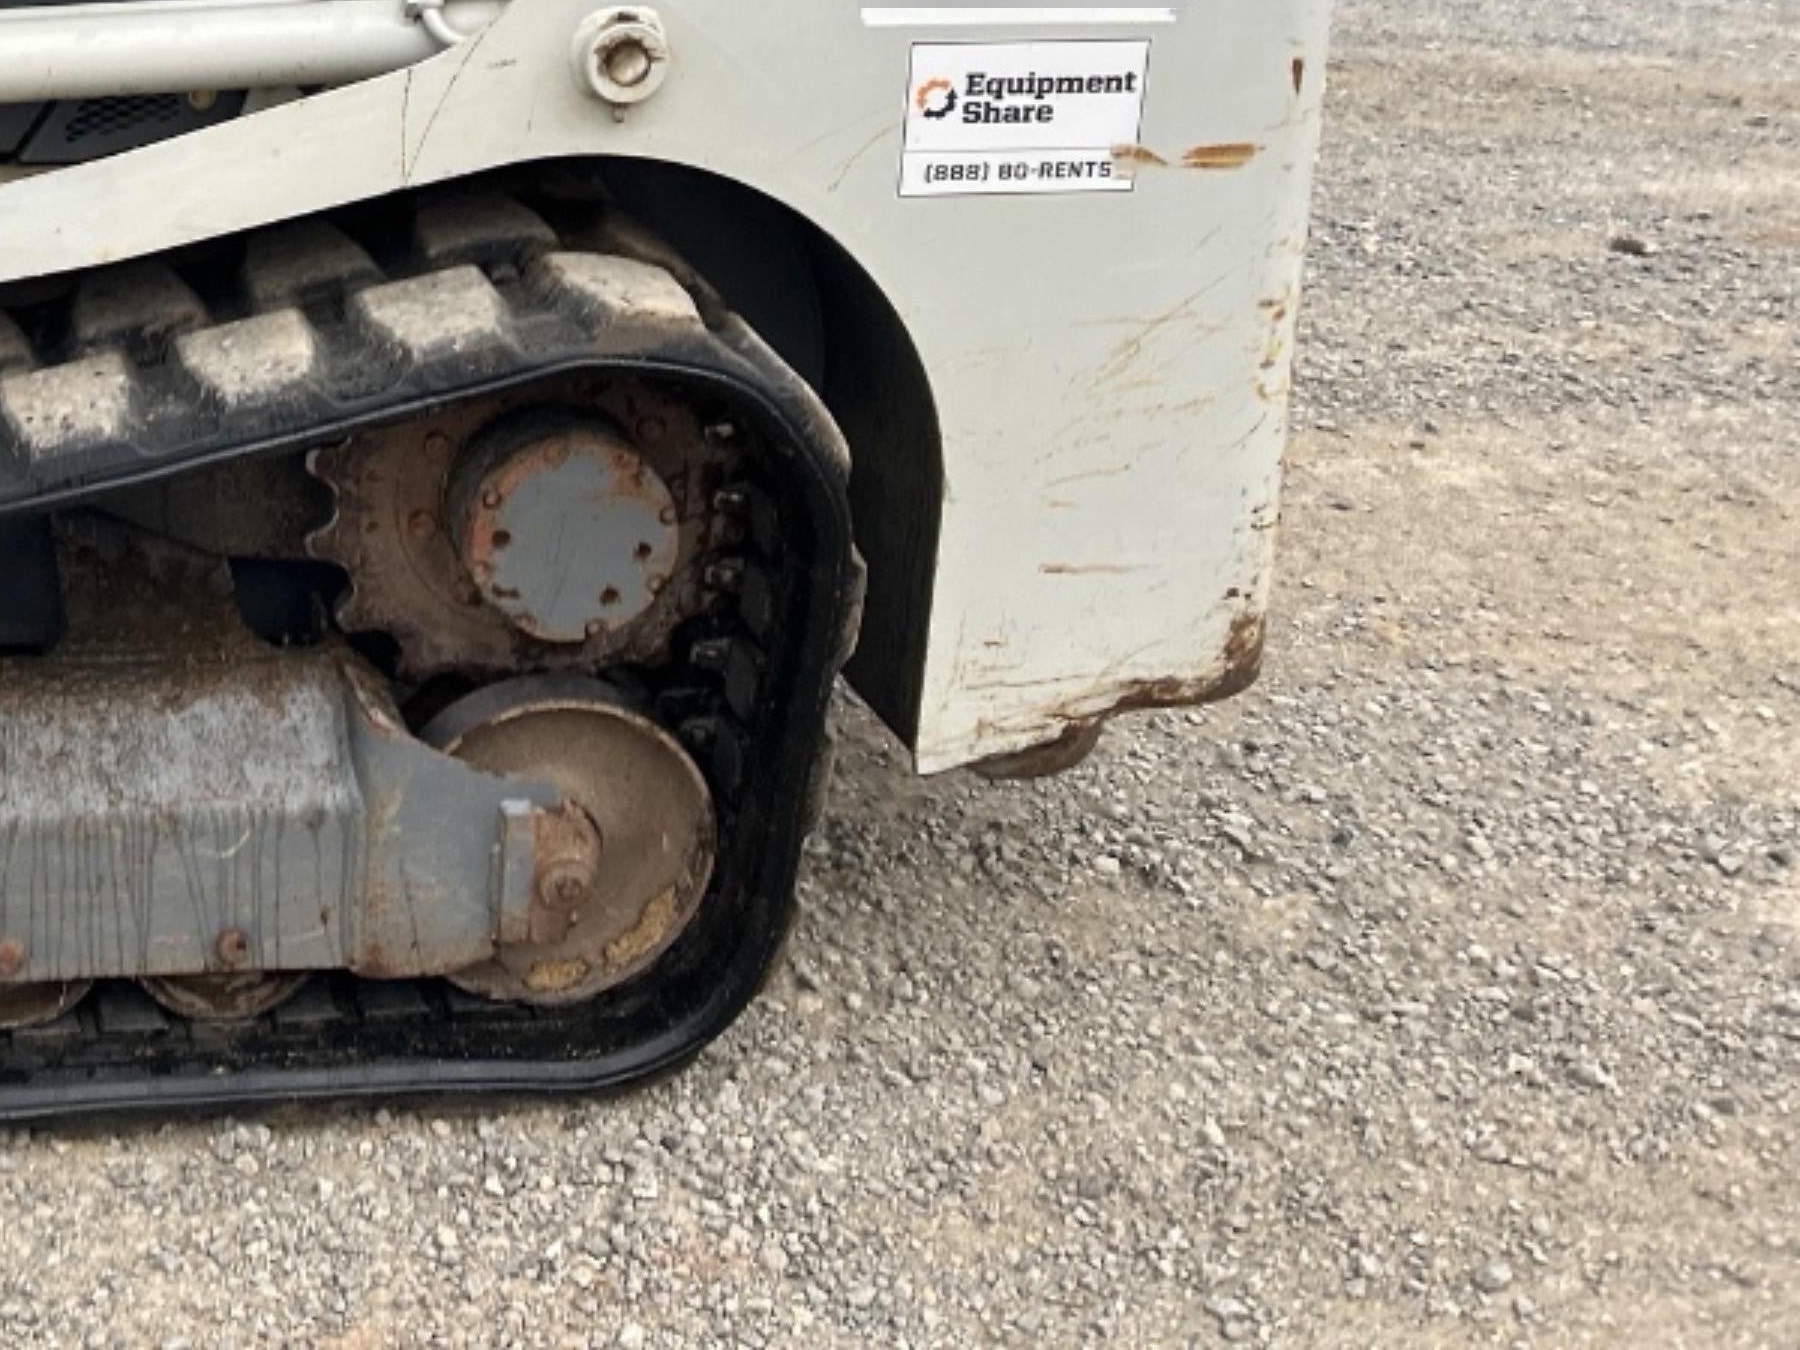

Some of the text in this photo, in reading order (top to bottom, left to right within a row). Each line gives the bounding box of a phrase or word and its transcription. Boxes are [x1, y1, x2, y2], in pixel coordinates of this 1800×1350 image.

[964, 71, 1137, 99] Equipment
[961, 101, 1054, 124] Share
[923, 162, 990, 183] (888)
